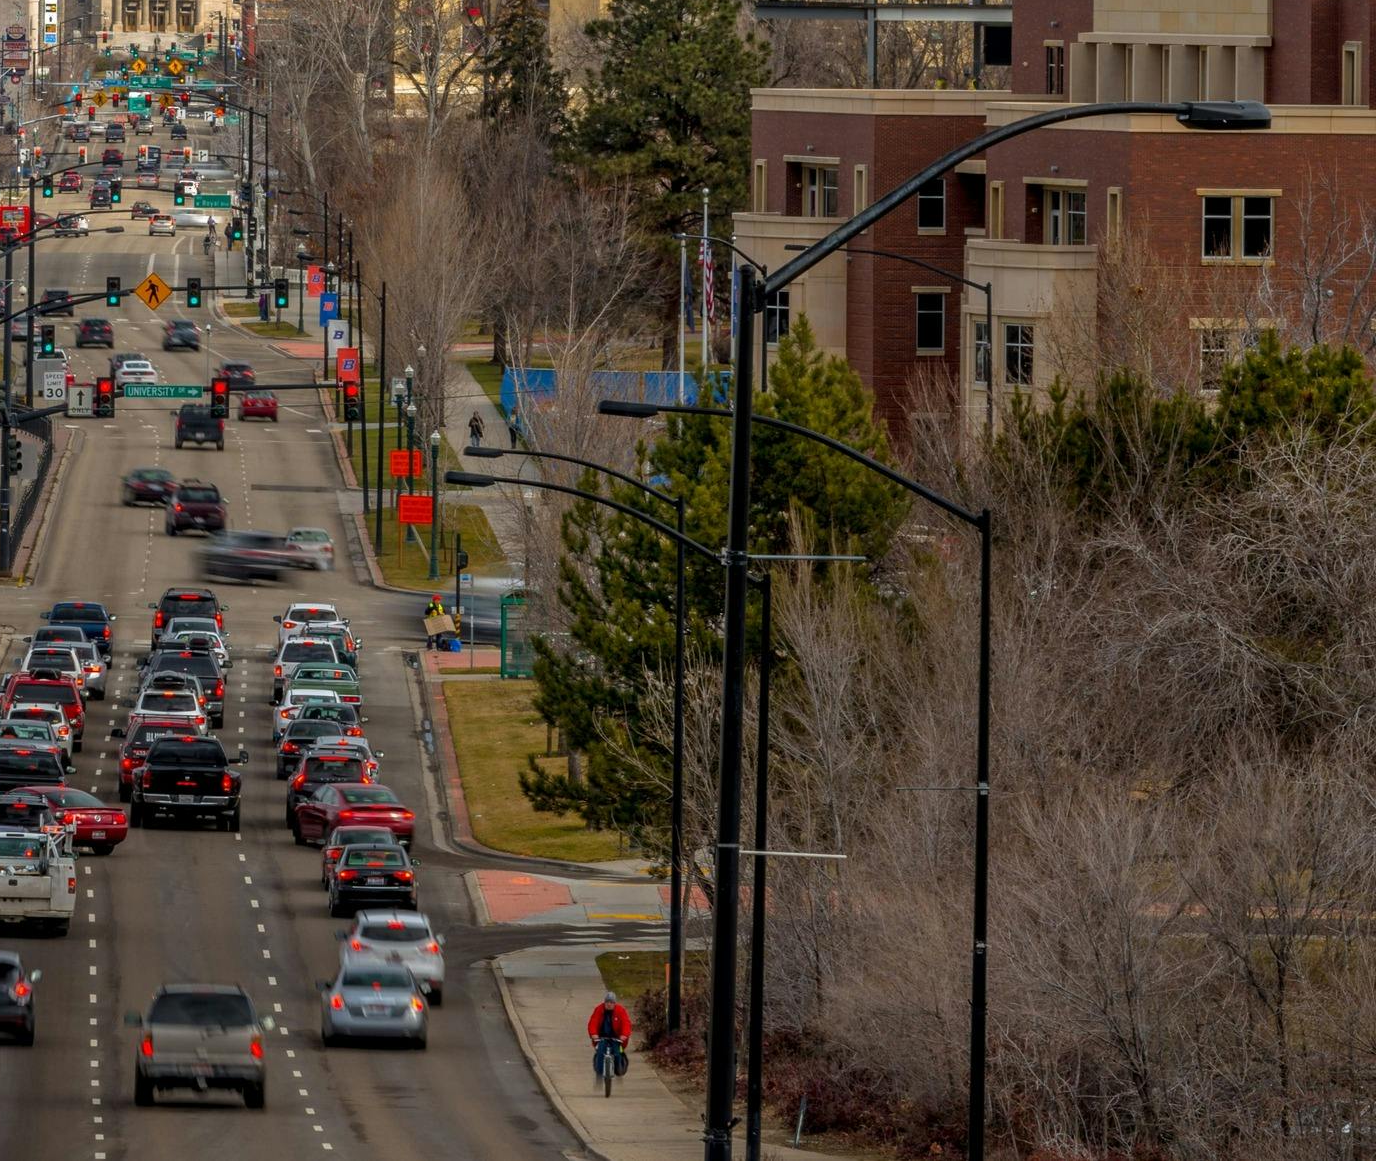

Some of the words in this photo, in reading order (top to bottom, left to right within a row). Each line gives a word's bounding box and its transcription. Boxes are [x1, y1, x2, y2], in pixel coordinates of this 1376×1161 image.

[333, 330, 344, 340] B
[342, 359, 355, 370] B
[46, 388, 63, 398] 30
[128, 386, 175, 397] UNIVERSITY
